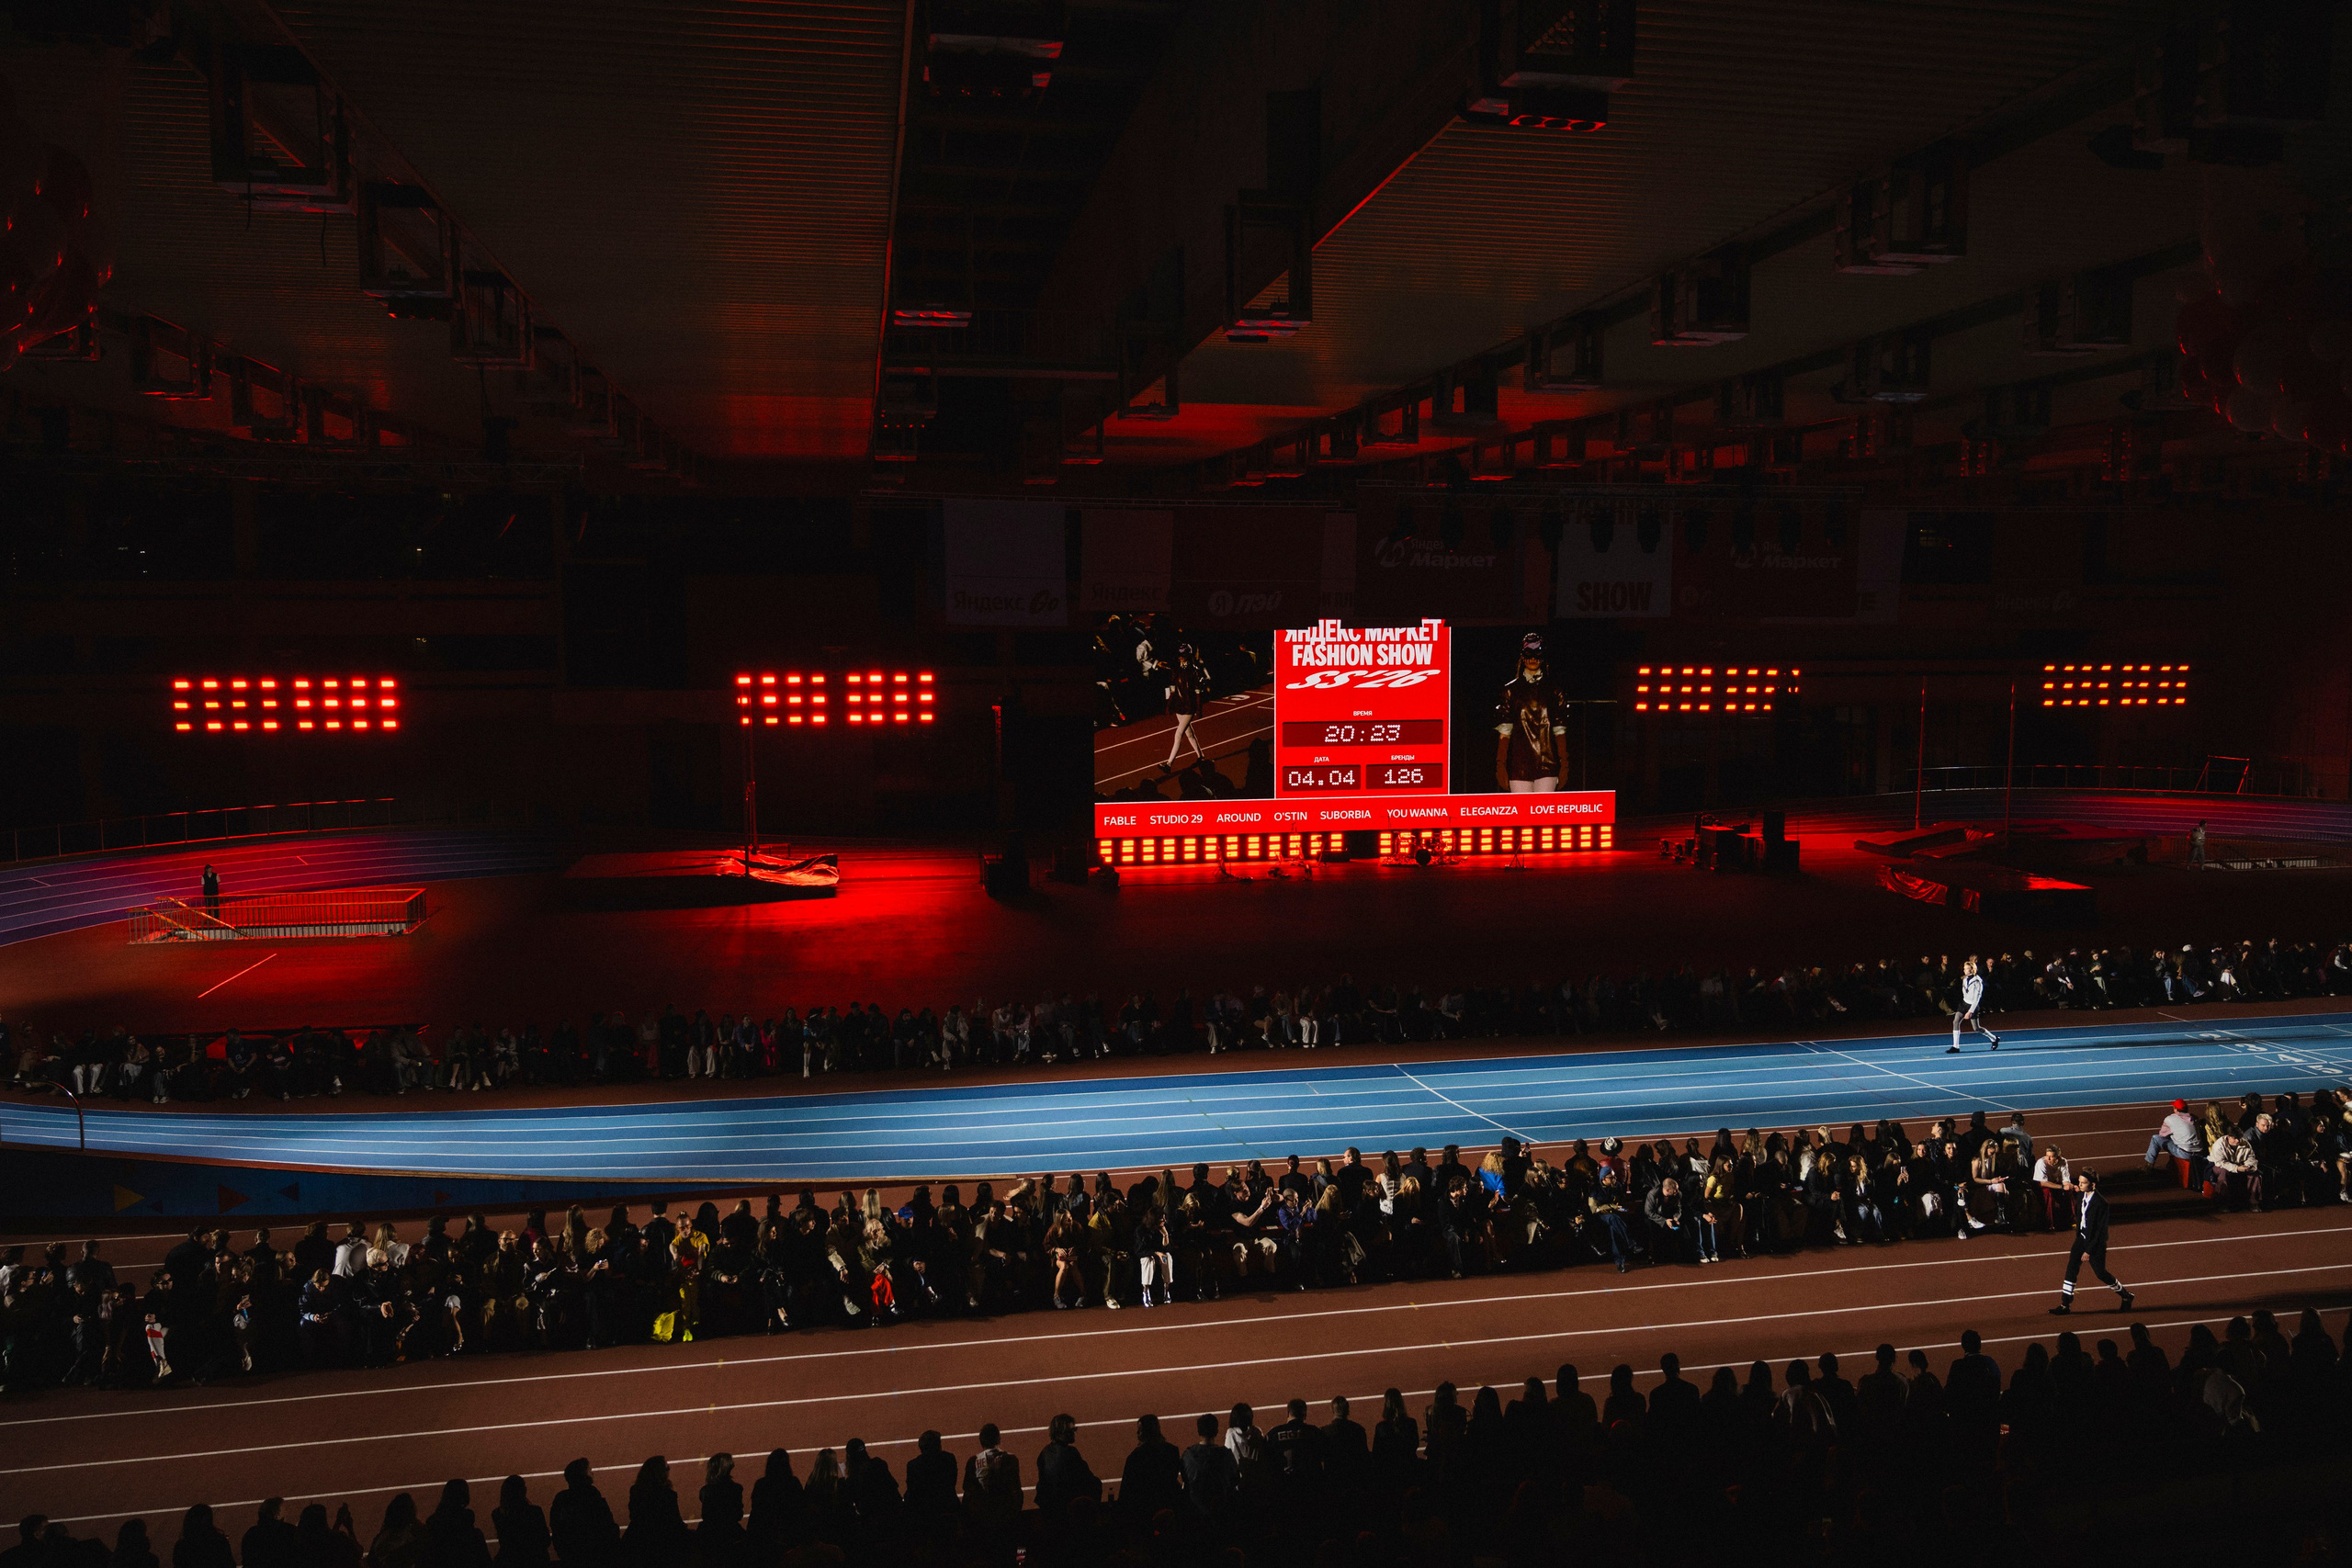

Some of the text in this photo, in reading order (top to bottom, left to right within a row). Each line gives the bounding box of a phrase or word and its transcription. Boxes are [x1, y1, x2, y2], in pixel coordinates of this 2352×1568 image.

[1409, 552, 1497, 570] Маркет
[1761, 555, 1841, 570] Маркет
[953, 589, 1060, 615] Яндекс Go
[1577, 581, 1653, 612] SHOW
[1292, 643, 1432, 666] FASHION SHOW
[1285, 670, 1441, 689] SS'26
[1325, 724, 1401, 743] 20:23
[1288, 770, 1355, 786] 04.04
[1385, 768, 1424, 784] 126
[1103, 803, 1603, 826] FABLE STUDIO 29 AROUND O'STIN SUBORBIA YOU WANNA ELEGANZZA LOVE REPUBLIC
[2235, 1043, 2268, 1052] 3
[2277, 1054, 2307, 1063] 4
[2306, 1064, 2344, 1074] 5
